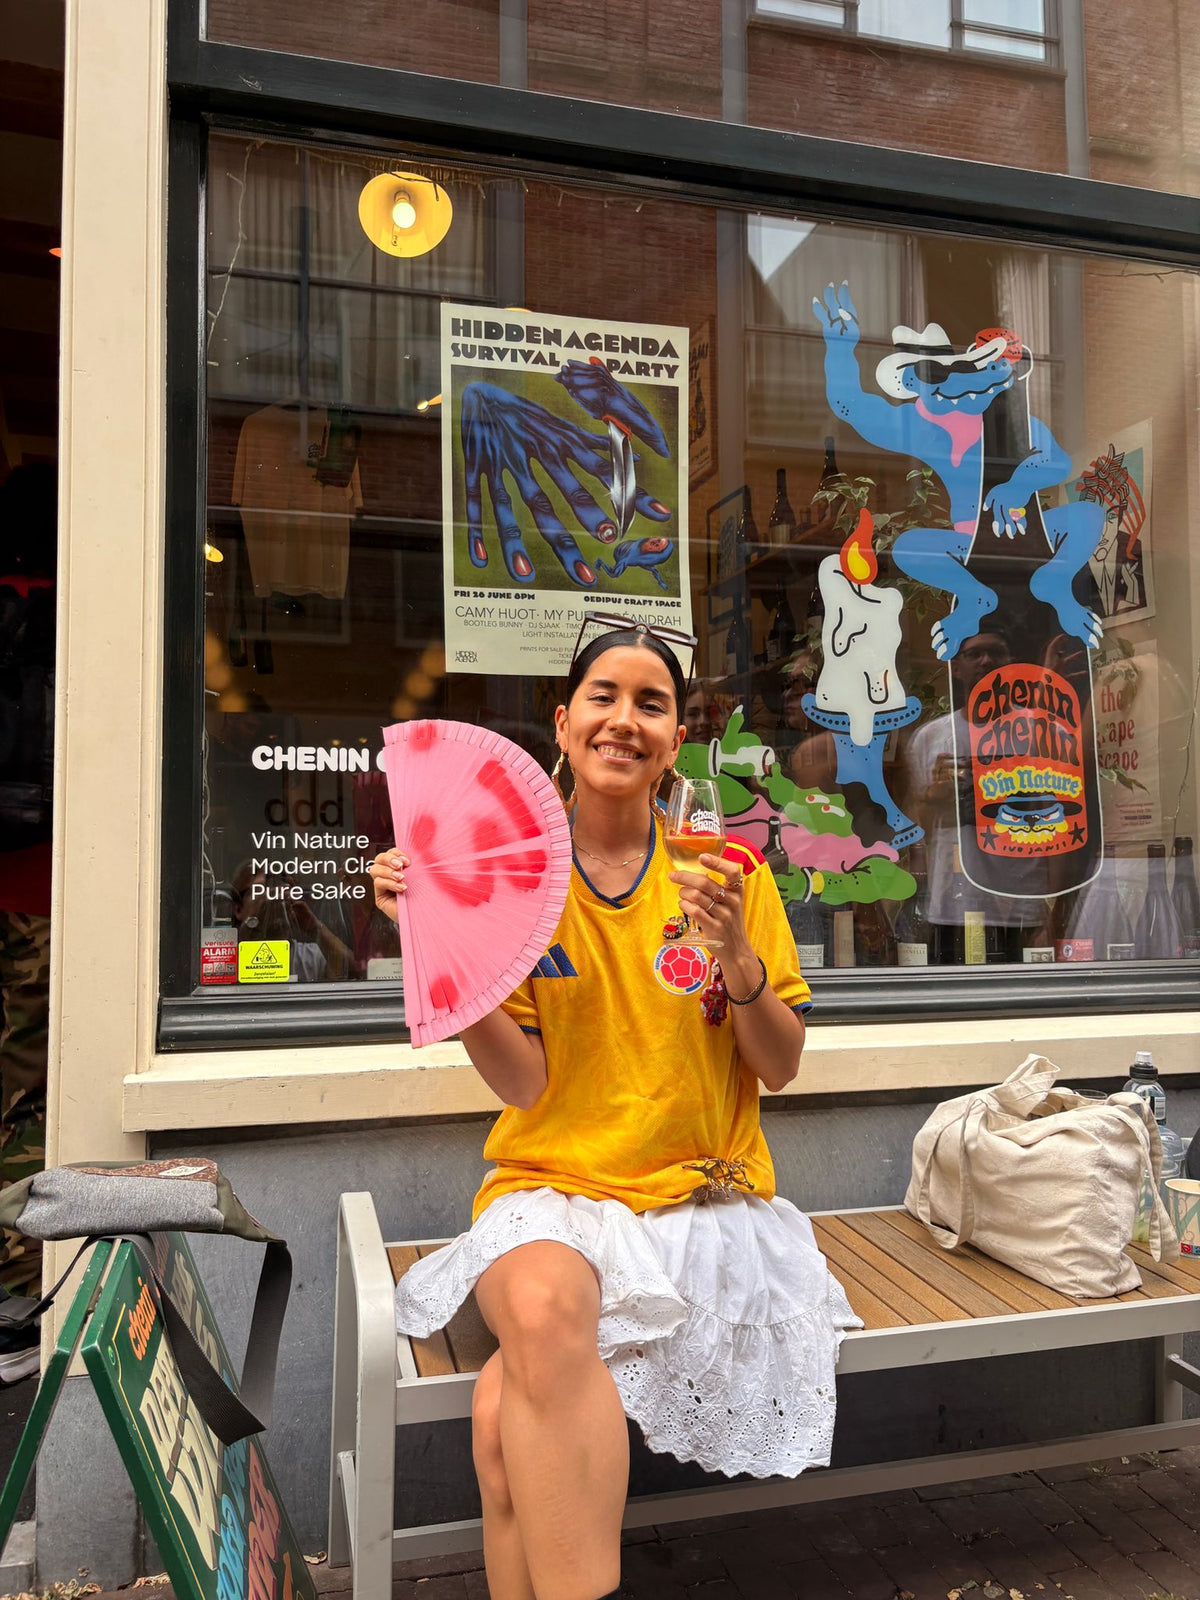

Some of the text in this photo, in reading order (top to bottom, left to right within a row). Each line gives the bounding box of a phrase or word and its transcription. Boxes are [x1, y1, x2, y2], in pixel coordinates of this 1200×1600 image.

[451, 342, 561, 368] SURVIVAL
[606, 358, 680, 380] PARTY
[454, 590, 470, 598] FRI
[487, 592, 512, 600] JUNE
[583, 595, 682, 608] OEDIPUS CRAFT SPACE
[455, 606, 495, 619] CAMY
[544, 610, 564, 621] MY
[463, 619, 497, 628] BOOTLEG
[499, 621, 524, 629] BUNNY
[566, 622, 595, 631] TIMOHY
[543, 632, 591, 640] INSTALLATON
[252, 745, 370, 773] CHENIN
[982, 768, 1081, 798] Vin Nature
[251, 831, 370, 849] Vin Nature
[251, 856, 375, 875] Modern Cla
[251, 882, 367, 901] Pure Sake
[203, 947, 236, 956] ALARM
